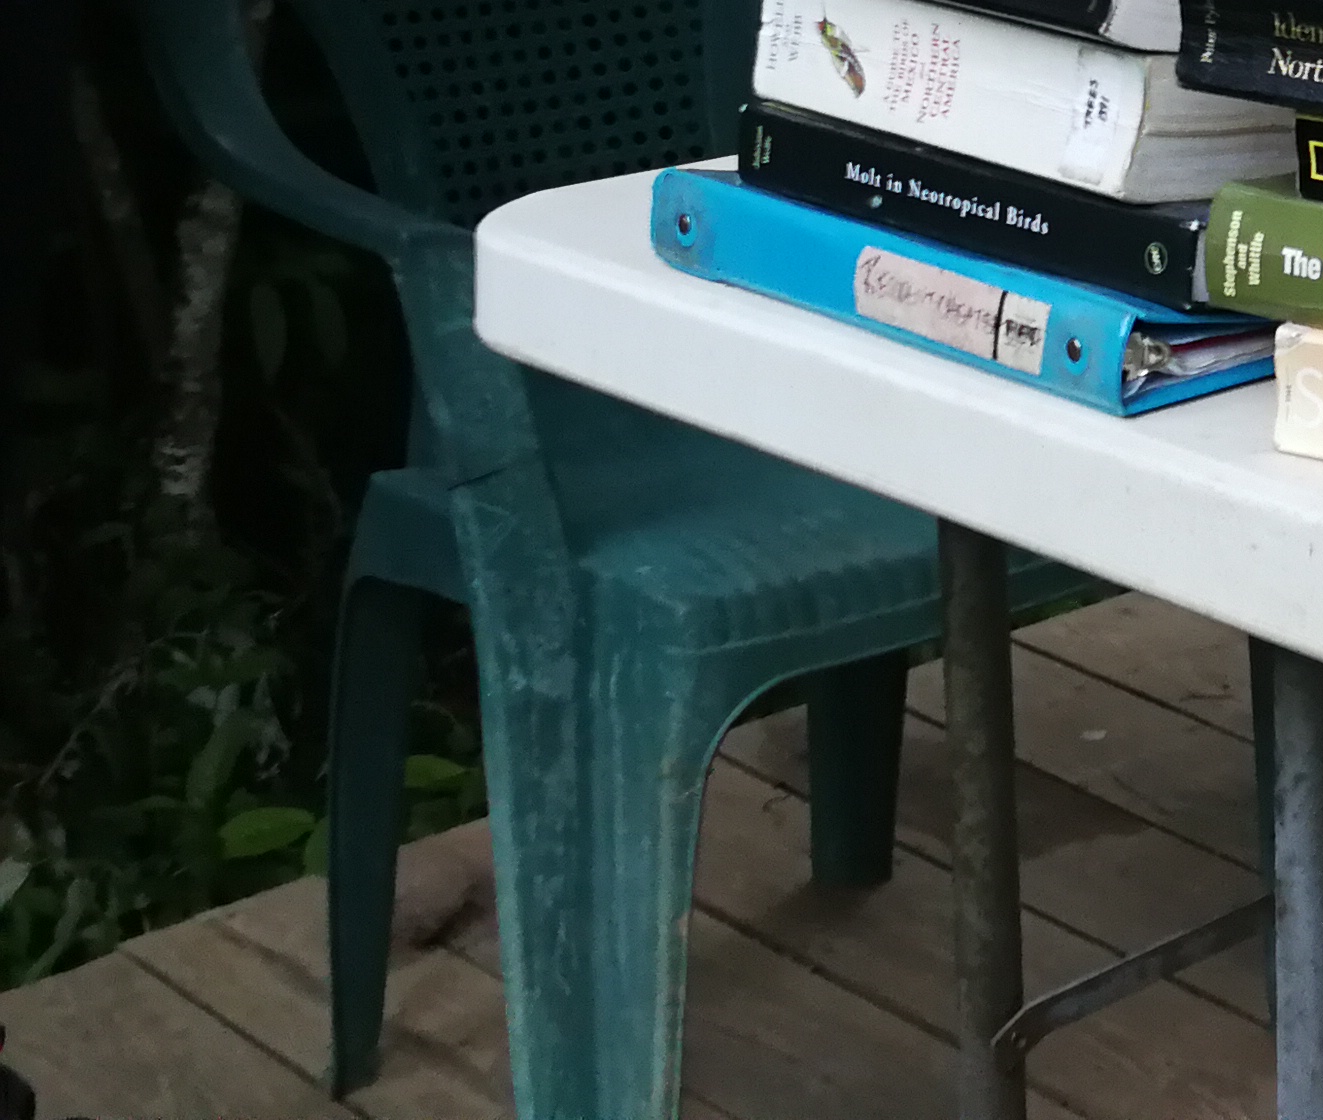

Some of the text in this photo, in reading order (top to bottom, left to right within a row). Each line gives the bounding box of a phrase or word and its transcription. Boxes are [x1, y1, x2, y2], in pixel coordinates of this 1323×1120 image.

[901, 32, 919, 103] MEXICO
[916, 22, 940, 124] NORTHERN
[930, 39, 950, 118] CENTRAL
[941, 38, 961, 119] AMERICA
[844, 161, 1050, 235] Molt in Neotropical Birds
[1222, 209, 1244, 298] Stephenson
[1237, 243, 1249, 270] and
[1248, 231, 1266, 286] Whittle
[1281, 246, 1323, 281] The
